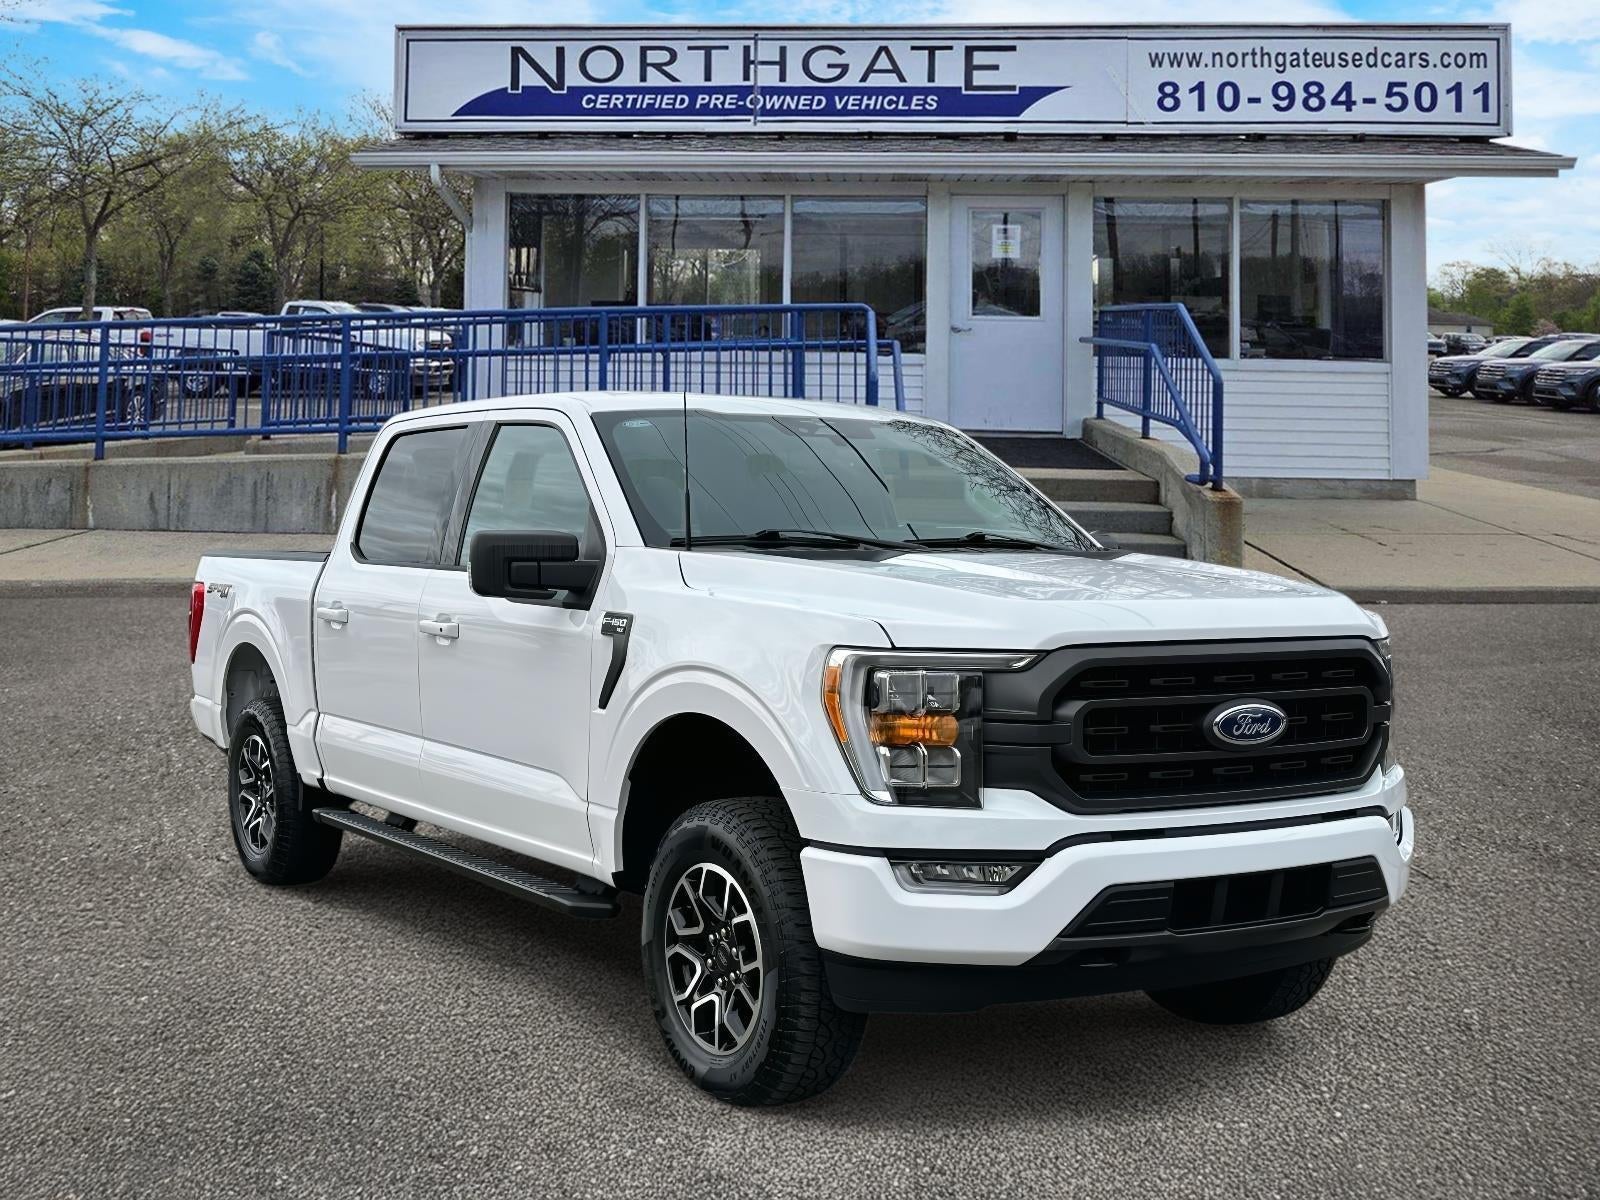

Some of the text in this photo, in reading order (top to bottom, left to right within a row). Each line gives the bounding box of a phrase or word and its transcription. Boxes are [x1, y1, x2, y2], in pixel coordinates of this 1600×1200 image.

[510, 44, 1018, 92] NORTHGATE
[1148, 46, 1489, 74] www.northgateusedcars.com
[580, 93, 939, 112] CERTIFIED PRE-OWNED VEHICLES
[1156, 80, 1491, 114] 810-984-5011
[602, 617, 627, 626] F-150
[1232, 713, 1272, 736] Ford
